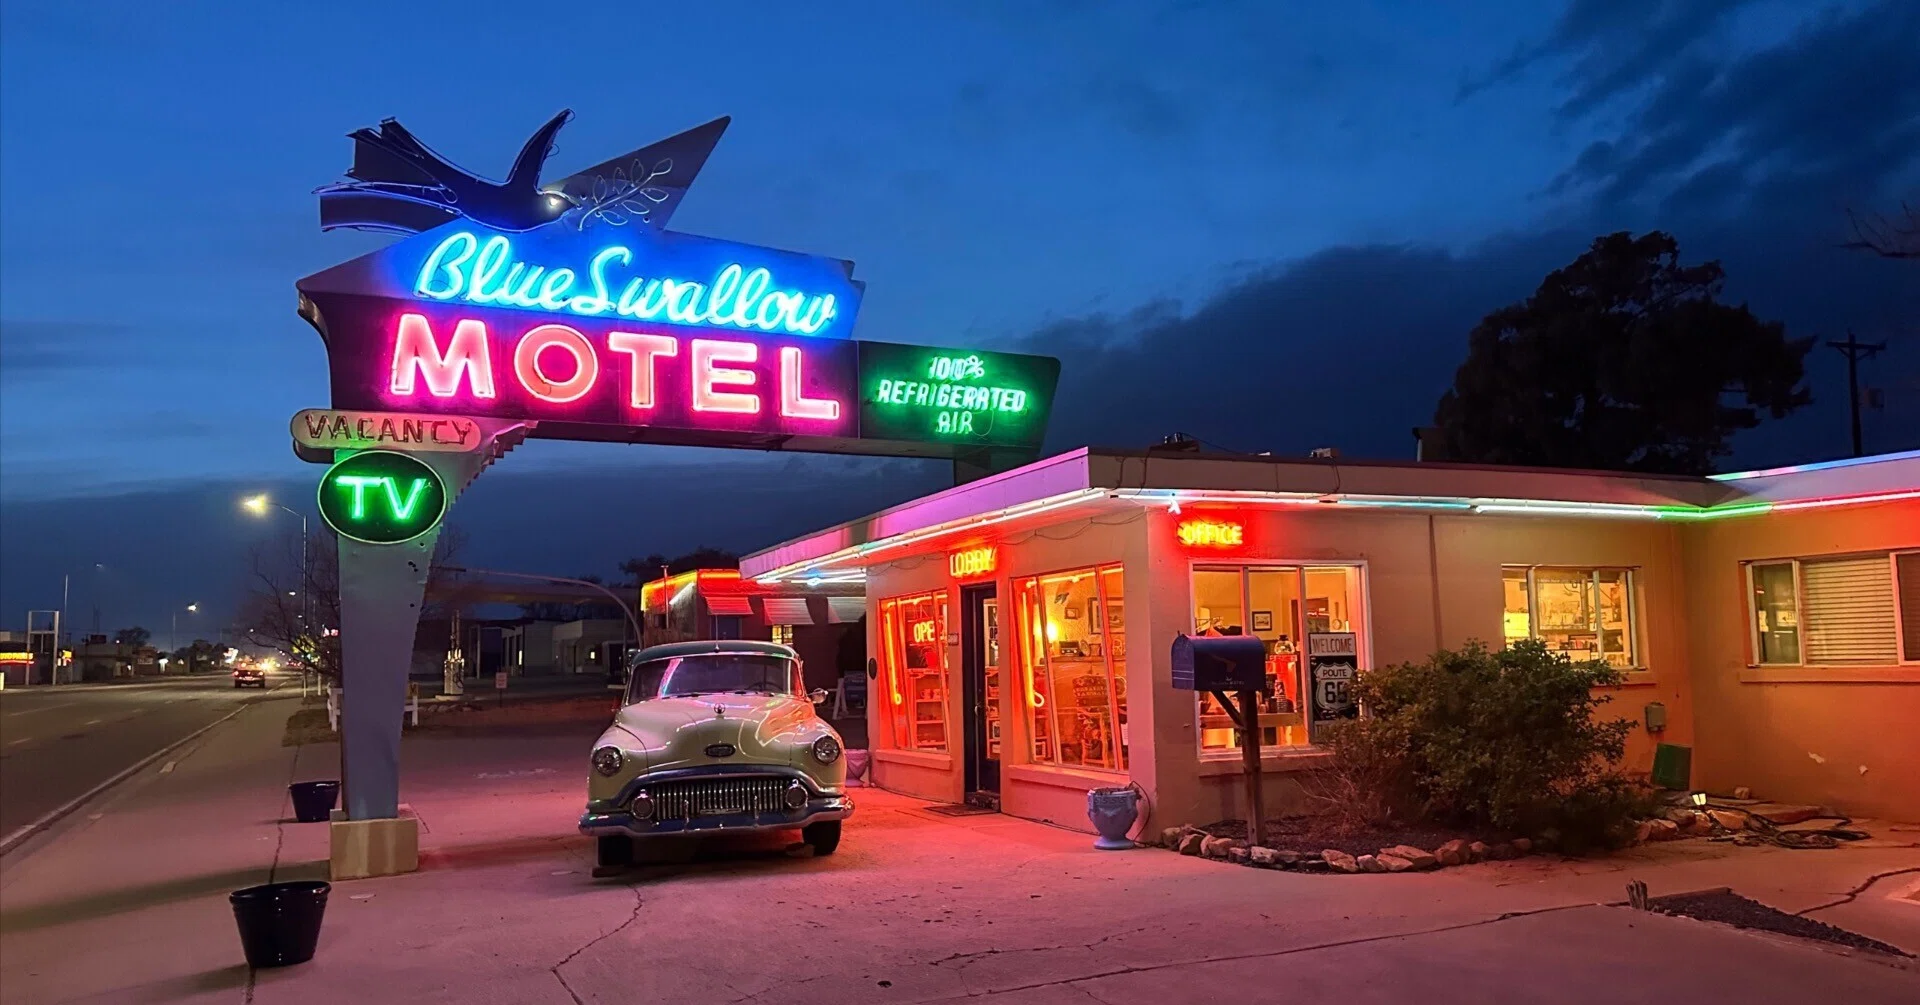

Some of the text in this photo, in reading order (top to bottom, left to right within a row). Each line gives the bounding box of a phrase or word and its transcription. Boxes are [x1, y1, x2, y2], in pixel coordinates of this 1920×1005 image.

[414, 231, 836, 332] Blue Swallow
[390, 313, 840, 421] MOTEL
[928, 355, 985, 381] 100%
[877, 379, 1027, 413] REFRIGERATED
[304, 413, 473, 445] VACANCY
[936, 410, 973, 434] AIR
[335, 475, 427, 519] TV
[1178, 522, 1243, 545] OFFICE
[949, 547, 997, 577] LOBBY
[913, 620, 939, 643] OPE
[1312, 638, 1353, 653] WELCOME
[1322, 669, 1348, 677] ROUTE
